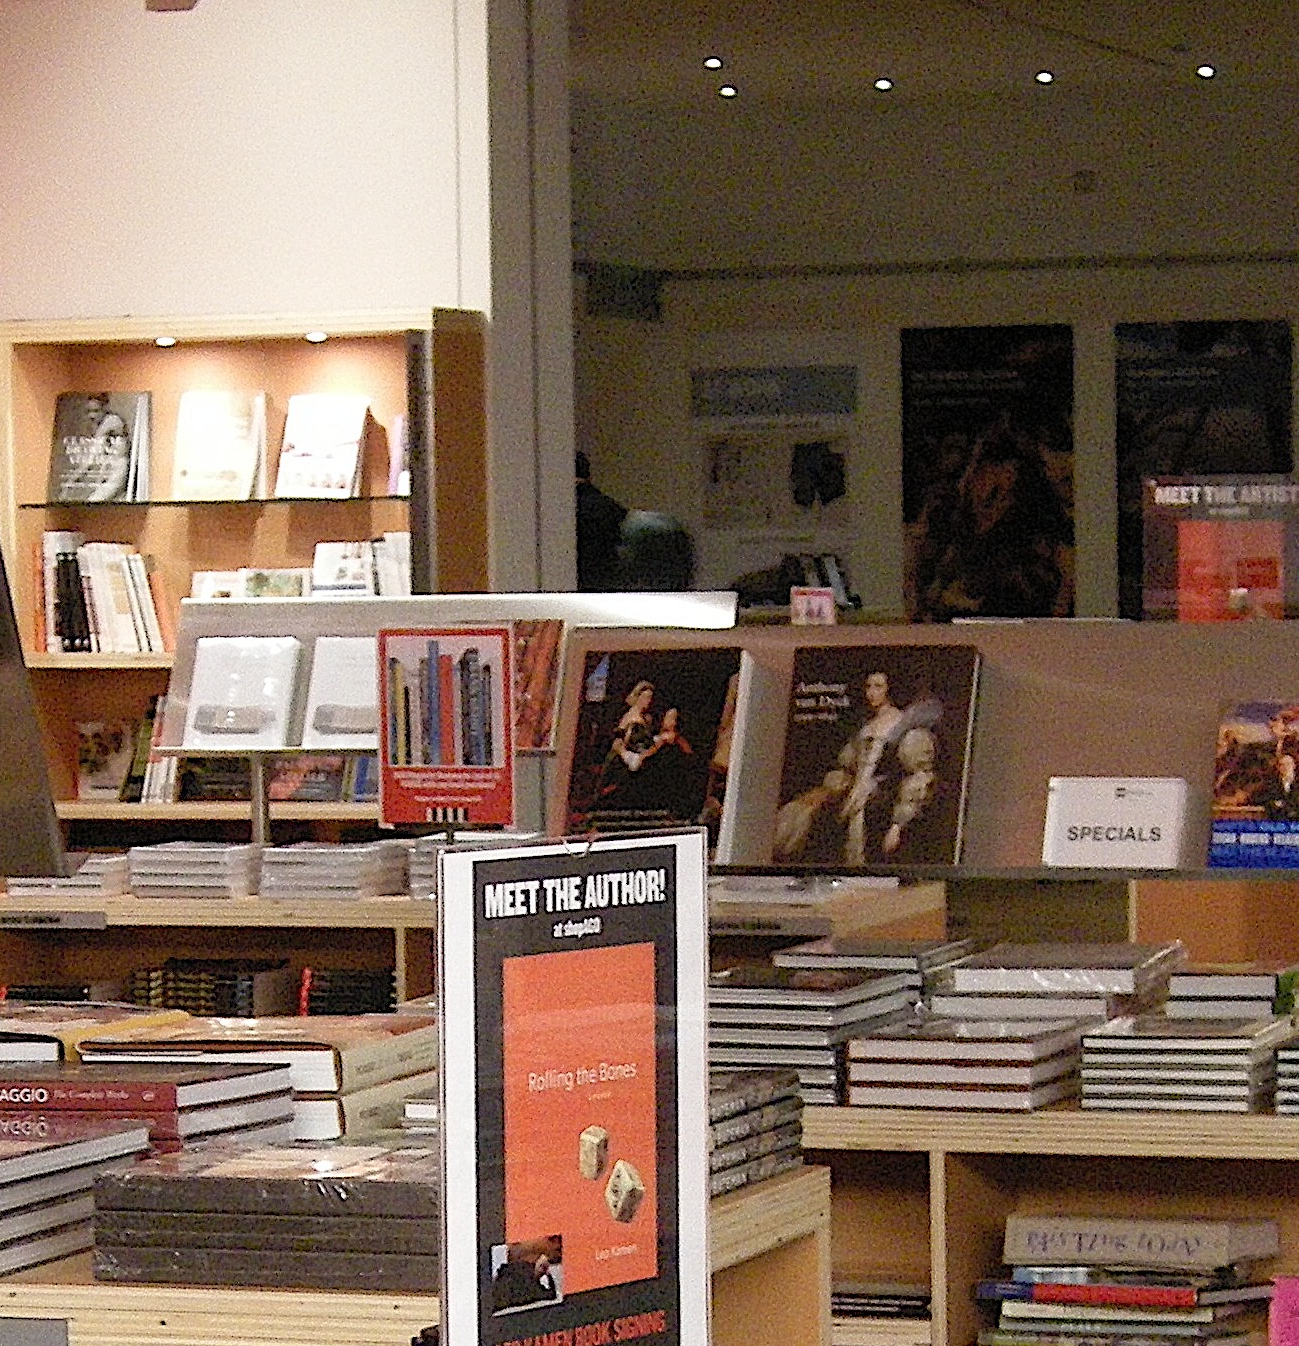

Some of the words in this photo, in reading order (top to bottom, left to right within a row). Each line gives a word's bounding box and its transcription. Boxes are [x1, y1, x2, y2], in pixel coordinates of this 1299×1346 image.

[1067, 826, 1162, 842] SPECIALS
[484, 881, 541, 920] MEET
[542, 876, 582, 913] THE
[584, 868, 666, 909] AUTHOR!
[528, 1071, 574, 1092] Rolling
[576, 1067, 597, 1085] the
[599, 1062, 637, 1082] Bones
